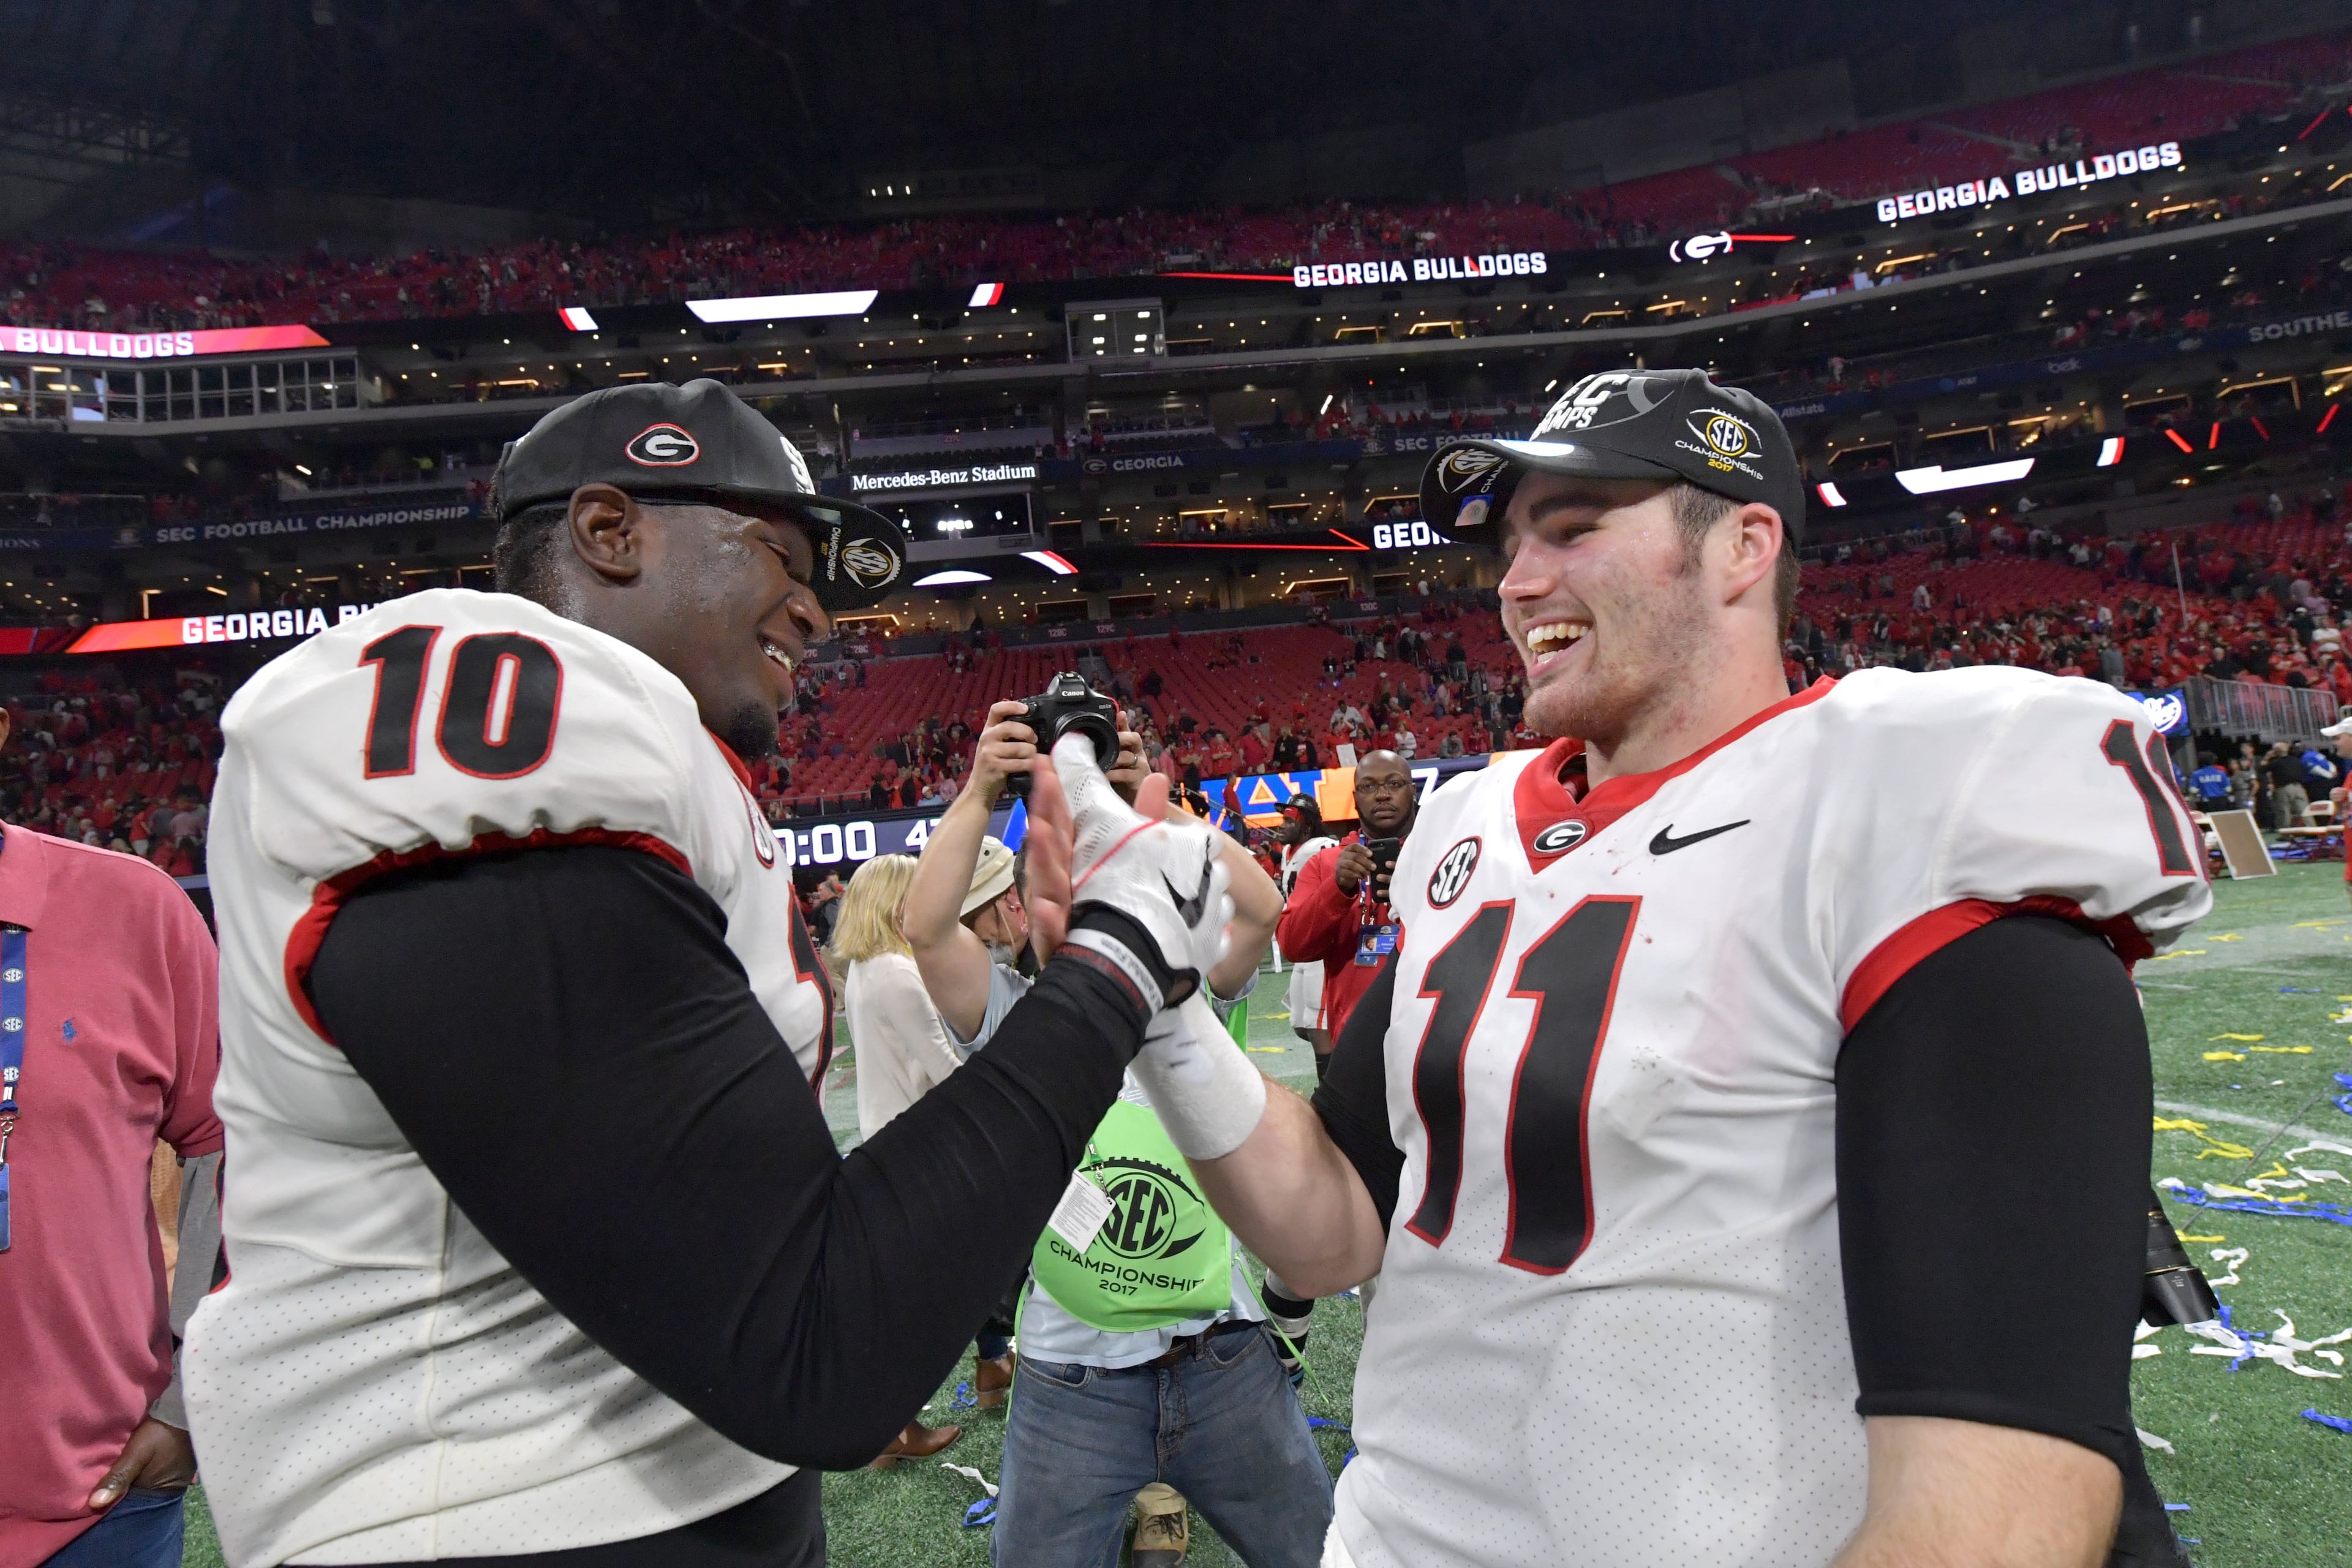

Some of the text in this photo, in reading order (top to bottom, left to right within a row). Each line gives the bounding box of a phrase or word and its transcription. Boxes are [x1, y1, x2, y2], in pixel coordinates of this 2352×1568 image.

[1877, 142, 2182, 222] GEORGIA BULLDOGS
[1294, 252, 1547, 287] GEORGIA BULLDOGS
[16, 328, 194, 358] BULLDOGS
[1395, 437, 1428, 451] SEC
[1711, 420, 1743, 451] SEC
[1113, 455, 1183, 470] GEORGIA
[1675, 440, 1763, 481] CHAMPIONSHIP
[1708, 458, 1733, 472] 2017
[853, 464, 1036, 490] Mercedes-Benz Stadium
[156, 527, 196, 543] SEC
[204, 518, 308, 540] FOOTBALL
[315, 506, 470, 530] CHAMPIONSHIP
[826, 527, 842, 581] CHAMPIONSHIP
[183, 608, 328, 644] GEORGIA
[1096, 624, 1115, 634] 129C
[358, 624, 564, 780] 10
[1431, 840, 1477, 903] SEC
[5, 970, 21, 982] SEC
[4, 1018, 21, 1031] SEC
[4, 1068, 19, 1080] SEC
[1404, 894, 1643, 1275] 11
[1102, 1178, 1169, 1253] SEC
[1099, 1279, 1138, 1296] 2017
